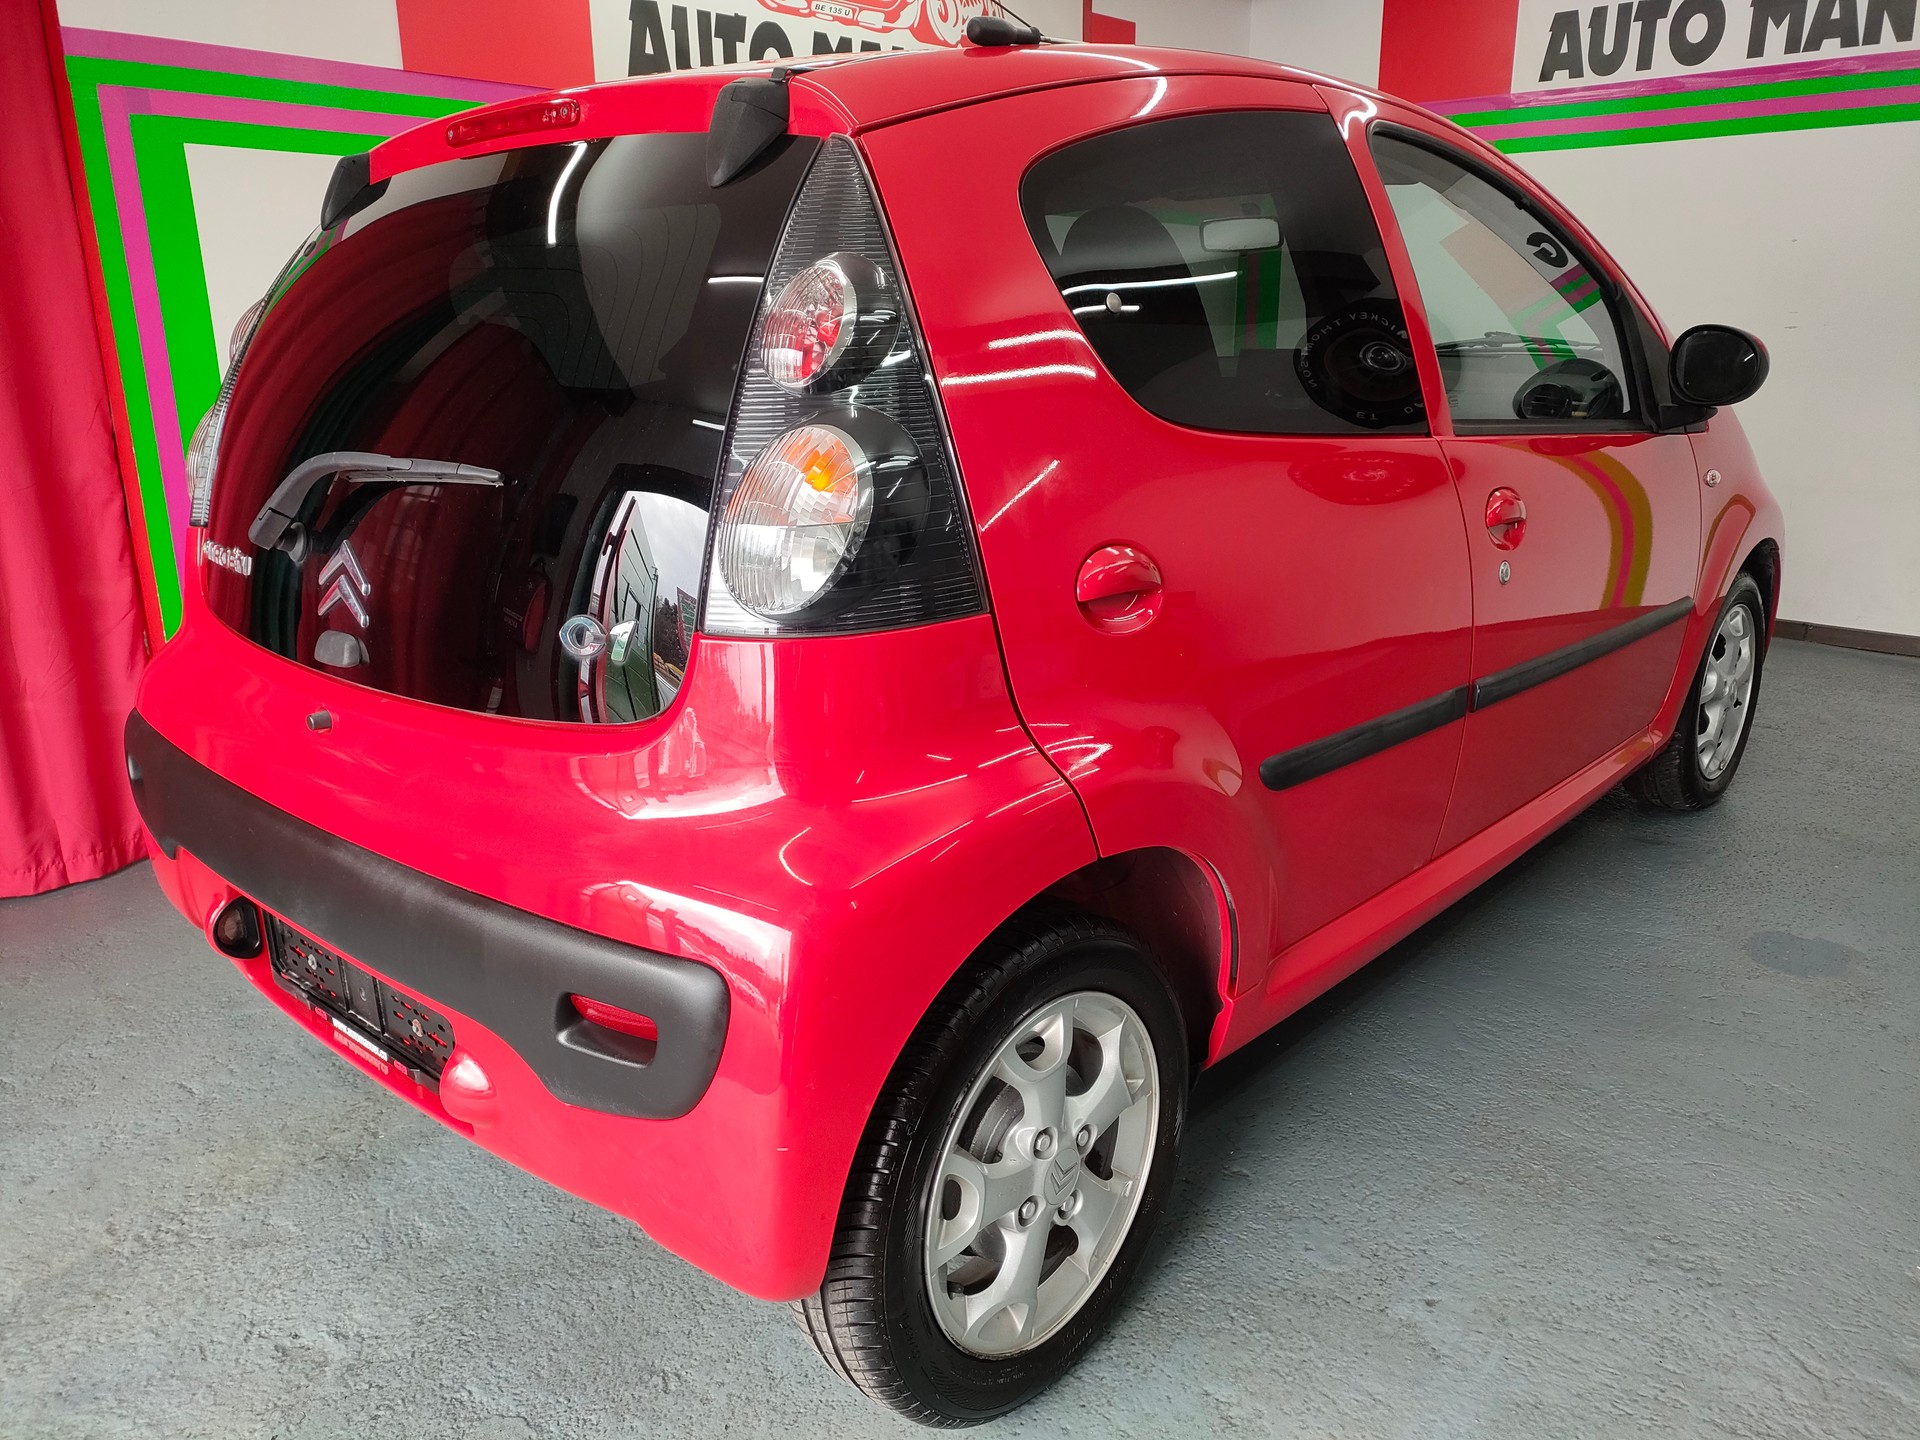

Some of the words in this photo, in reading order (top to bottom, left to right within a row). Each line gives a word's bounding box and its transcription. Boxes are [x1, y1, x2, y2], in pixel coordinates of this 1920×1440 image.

[628, 0, 795, 77] AUTO
[828, 6, 842, 15] 135
[1538, 0, 1727, 82] AUTO
[1746, 0, 1918, 59] MAN
